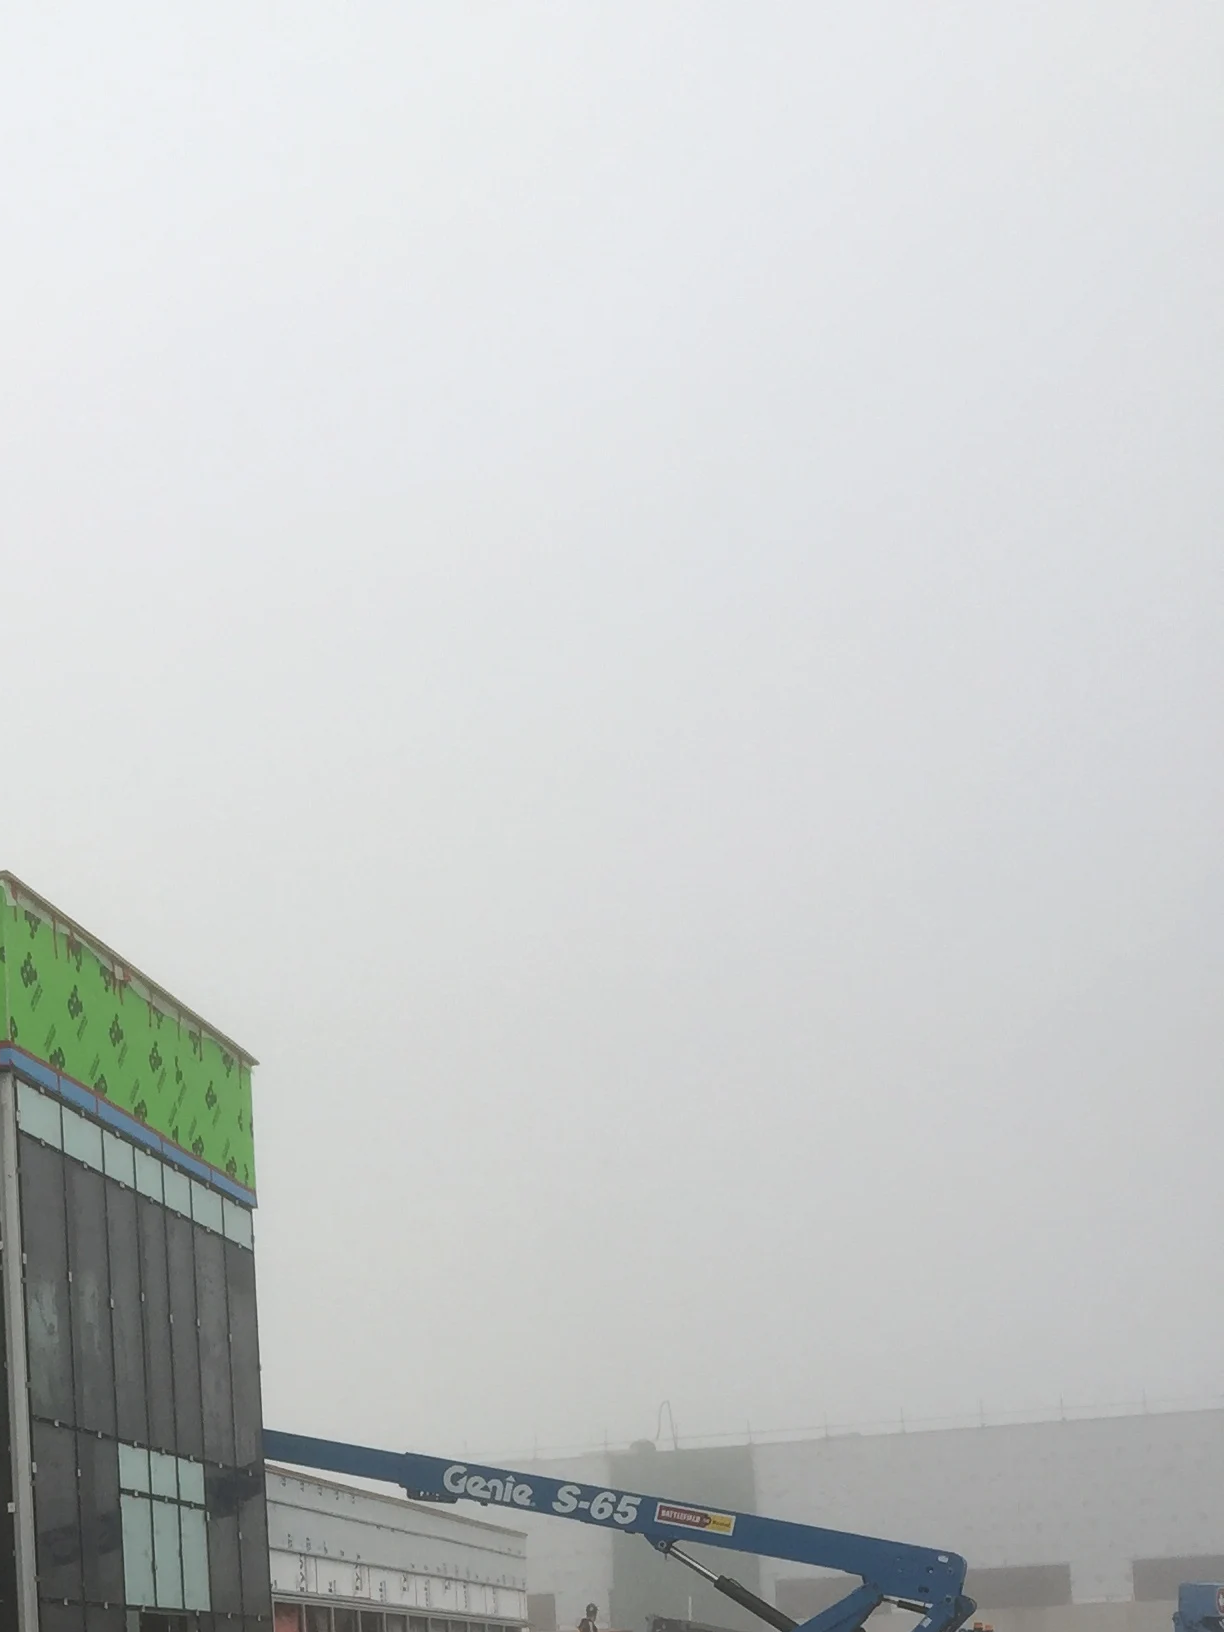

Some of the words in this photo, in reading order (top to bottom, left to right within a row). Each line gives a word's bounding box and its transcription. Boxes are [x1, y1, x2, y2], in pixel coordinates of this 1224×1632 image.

[443, 1465, 533, 1506] Genie
[552, 1485, 642, 1524] S-65
[660, 1509, 701, 1523] BATTLEFIELD
